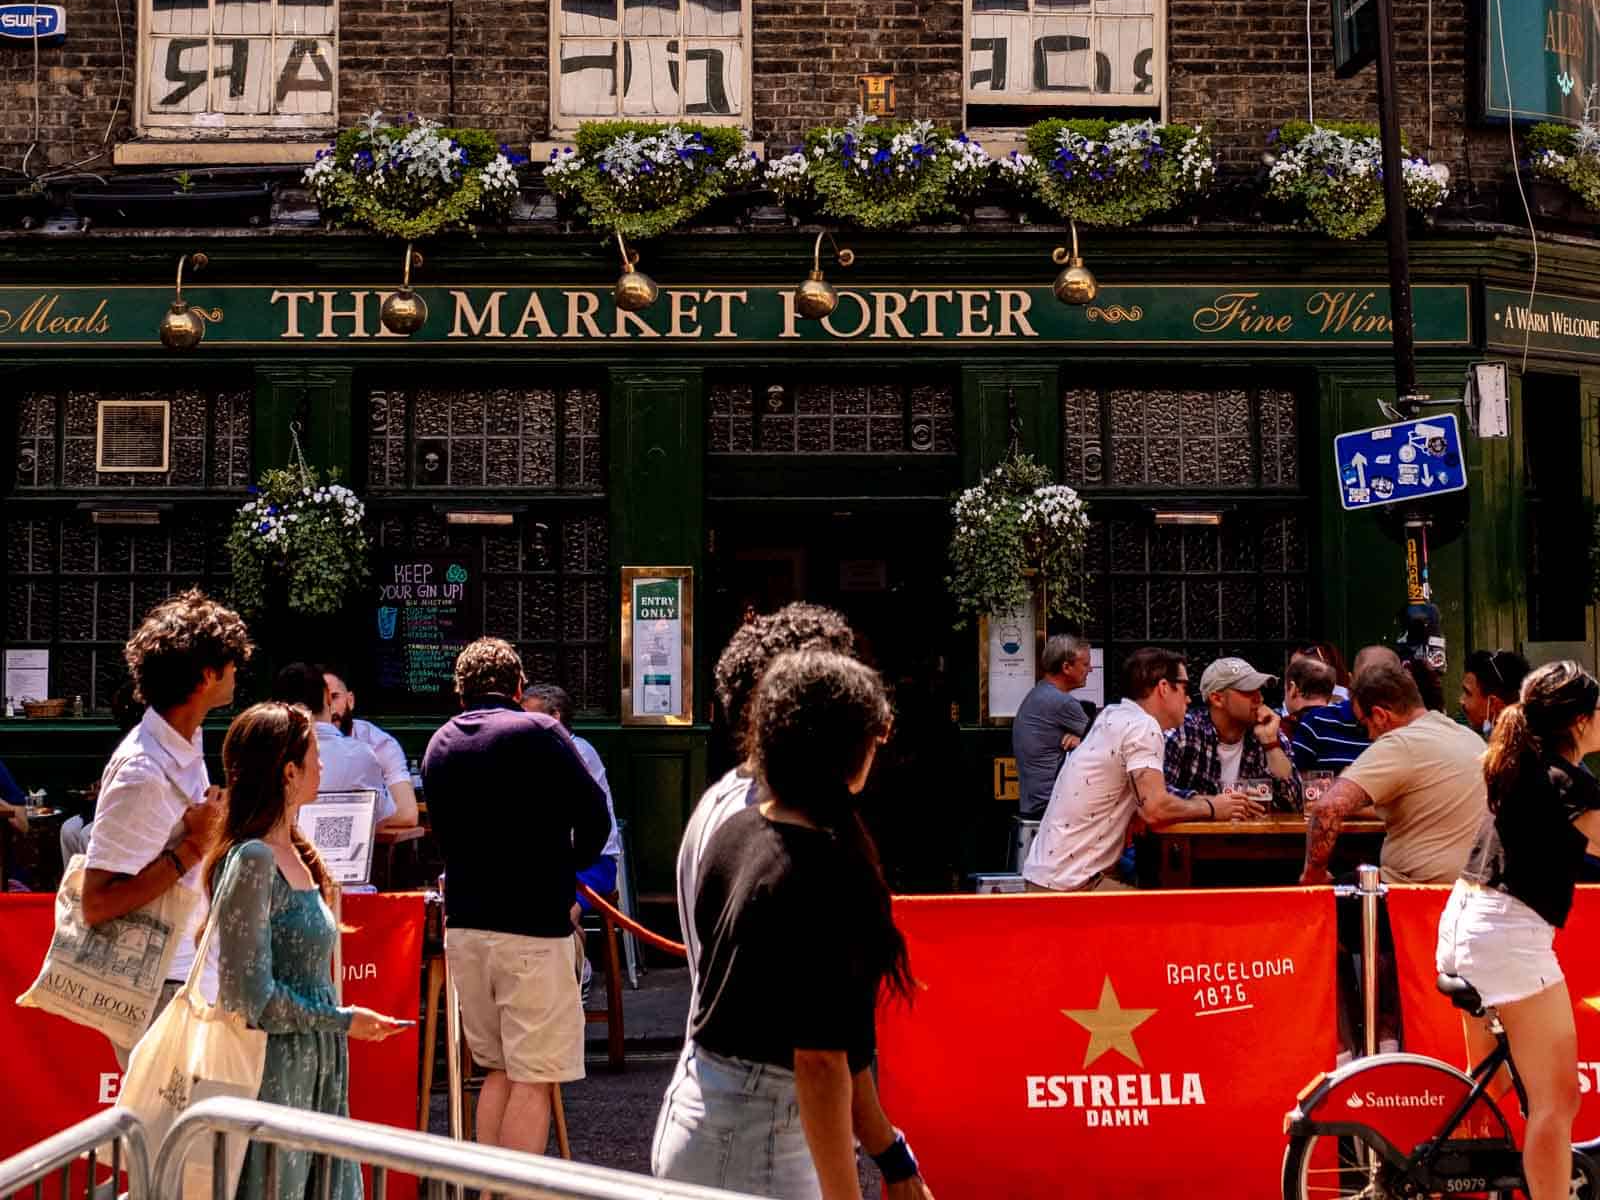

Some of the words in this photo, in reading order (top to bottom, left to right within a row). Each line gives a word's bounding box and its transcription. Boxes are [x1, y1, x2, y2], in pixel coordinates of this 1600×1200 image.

[0, 294, 110, 334] Meals
[1192, 292, 1295, 333] Fine
[1306, 292, 1416, 333] Win
[1504, 305, 1514, 329] A
[394, 563, 433, 584] KEEP
[380, 584, 412, 601] YOUR
[417, 584, 437, 598] GIN
[641, 597, 675, 606] ENTRY
[641, 608, 675, 618] ONLY
[1166, 958, 1294, 984] BARCELONA
[92, 992, 148, 1021] BOOKS
[1193, 984, 1247, 1009] 1876
[99, 1072, 125, 1104] E
[1026, 1072, 1206, 1108] ESTRELLA
[1366, 1090, 1445, 1108] Santander
[1086, 1109, 1150, 1127] DAMM
[1447, 1178, 1486, 1192] 50979
